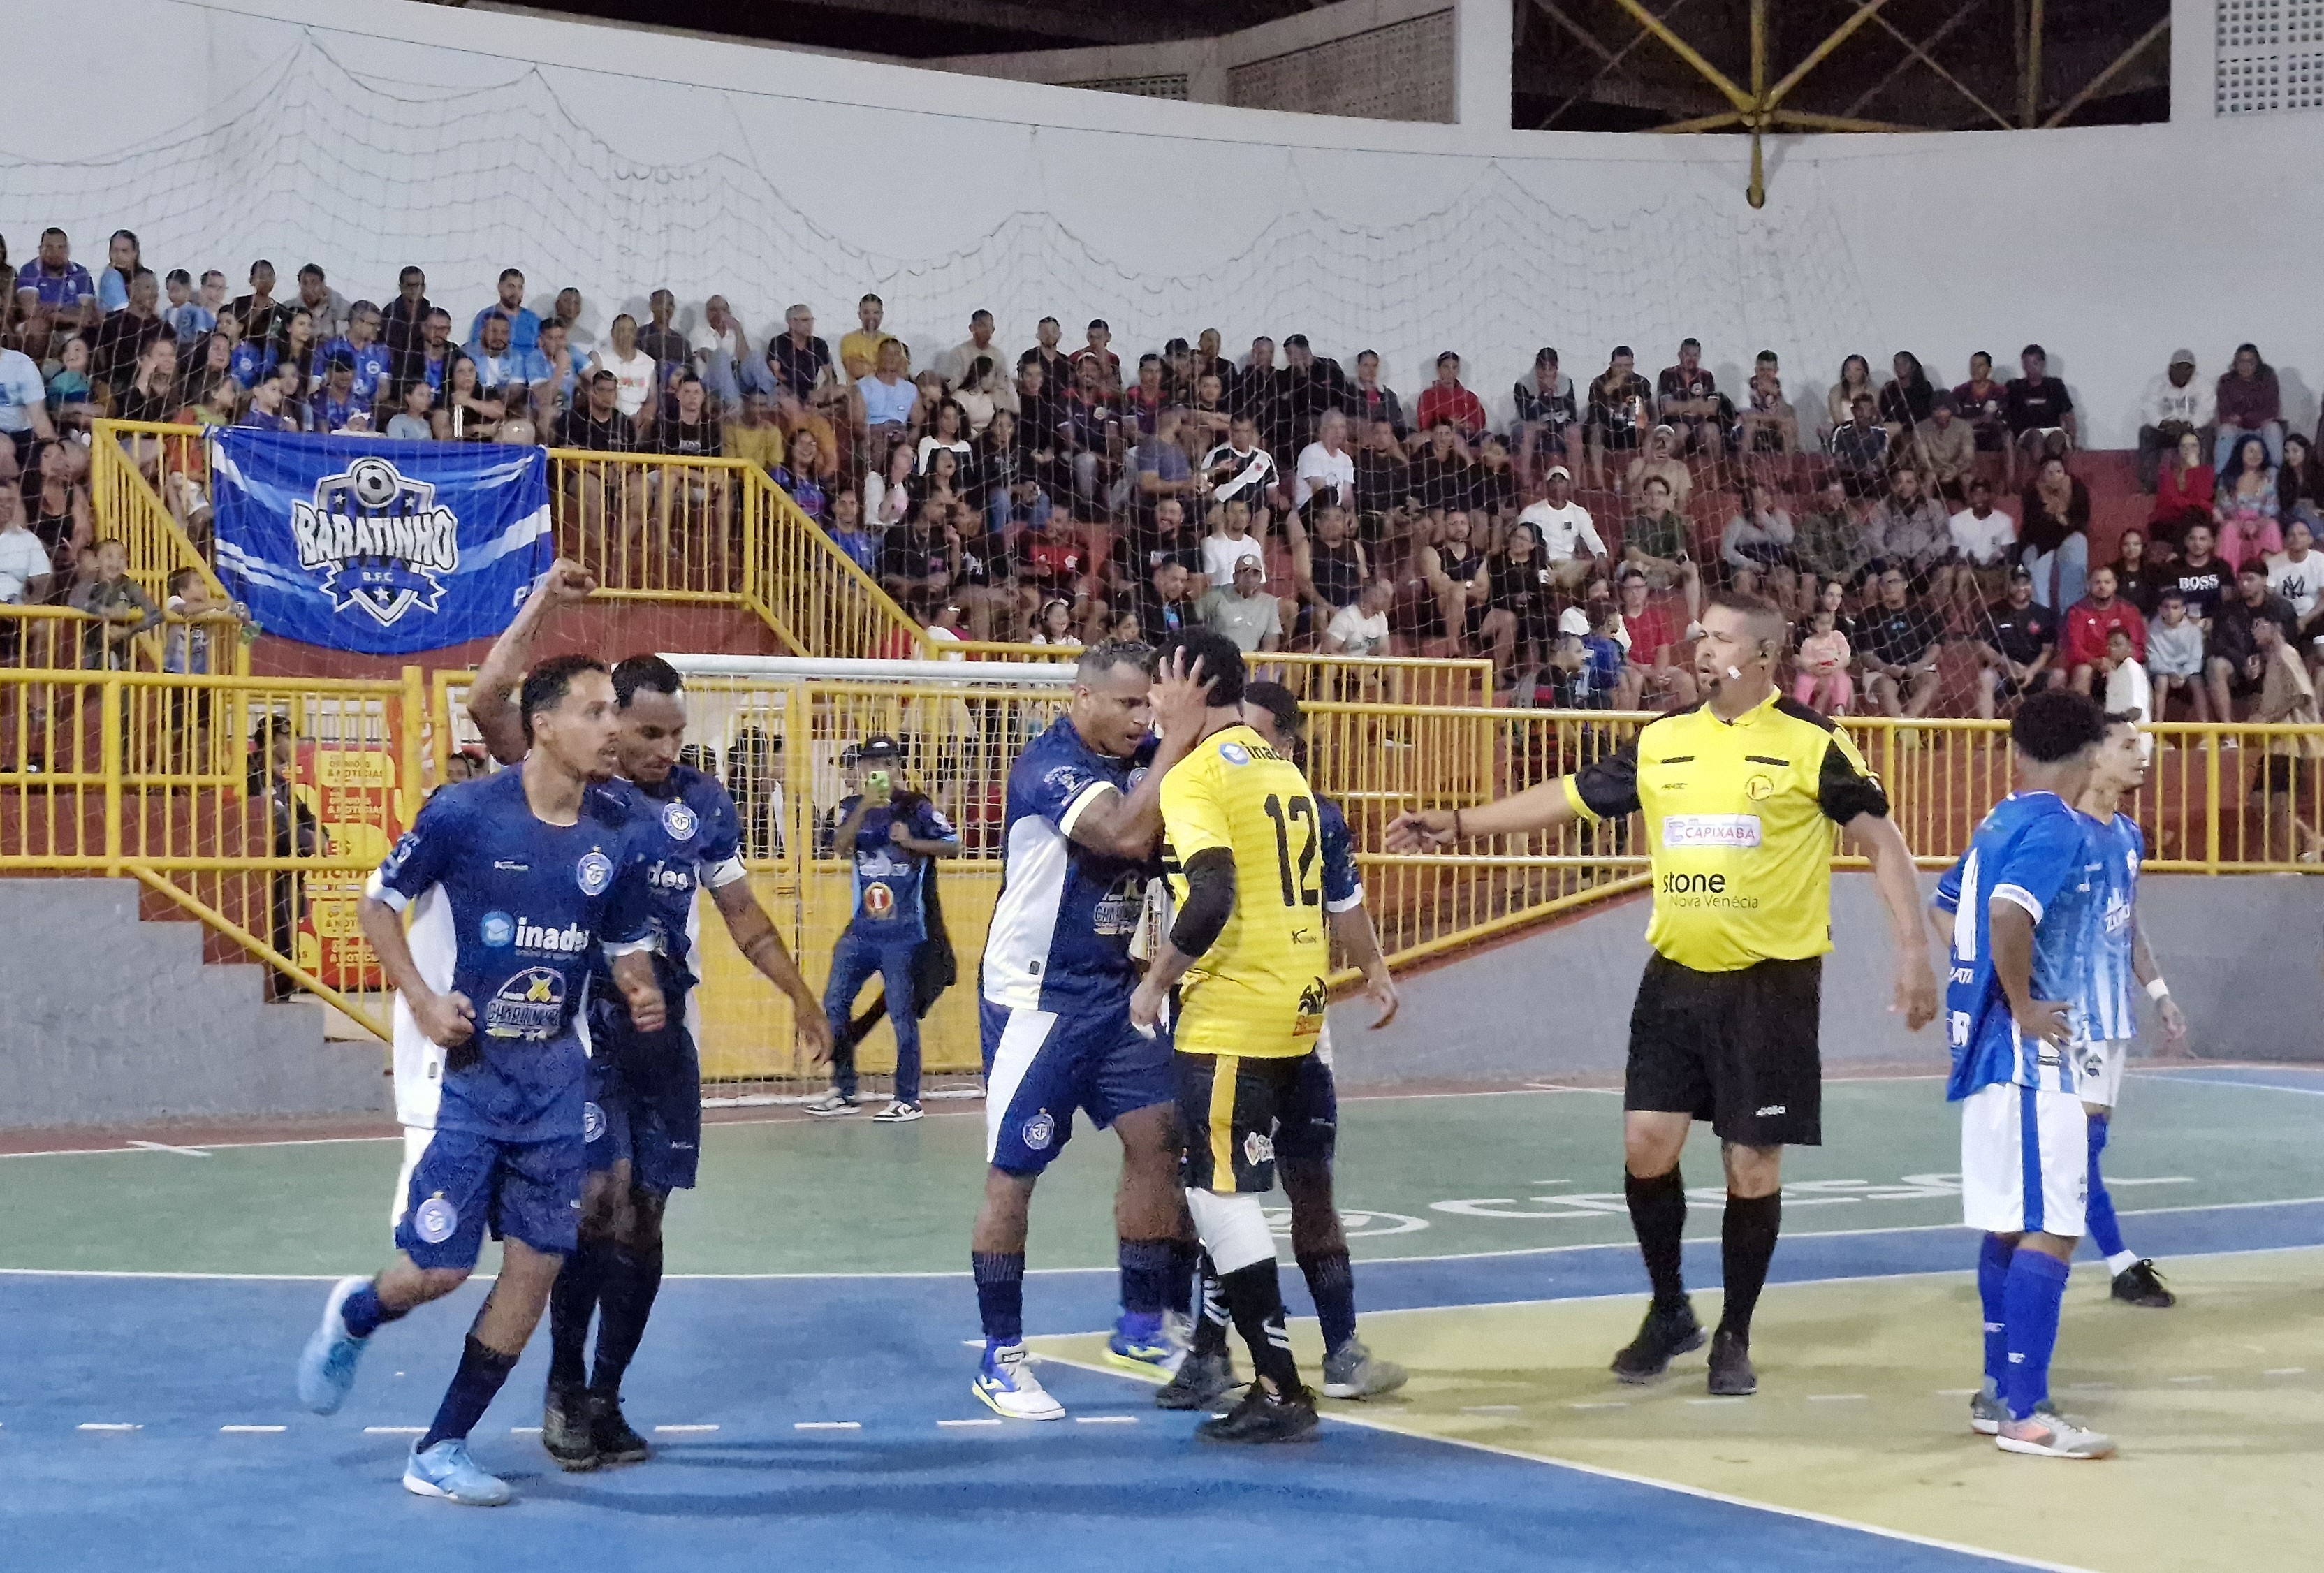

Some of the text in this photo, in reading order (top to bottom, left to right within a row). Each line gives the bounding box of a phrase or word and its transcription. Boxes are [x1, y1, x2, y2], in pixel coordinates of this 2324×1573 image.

[293, 500, 456, 571] BARATINHO
[2179, 574, 2219, 590] BOSS
[1685, 826, 1755, 840] CAPIXABA
[1264, 793, 1319, 907] 12
[1663, 871, 1726, 893] stone
[1670, 894, 1759, 909] Nova Venécia
